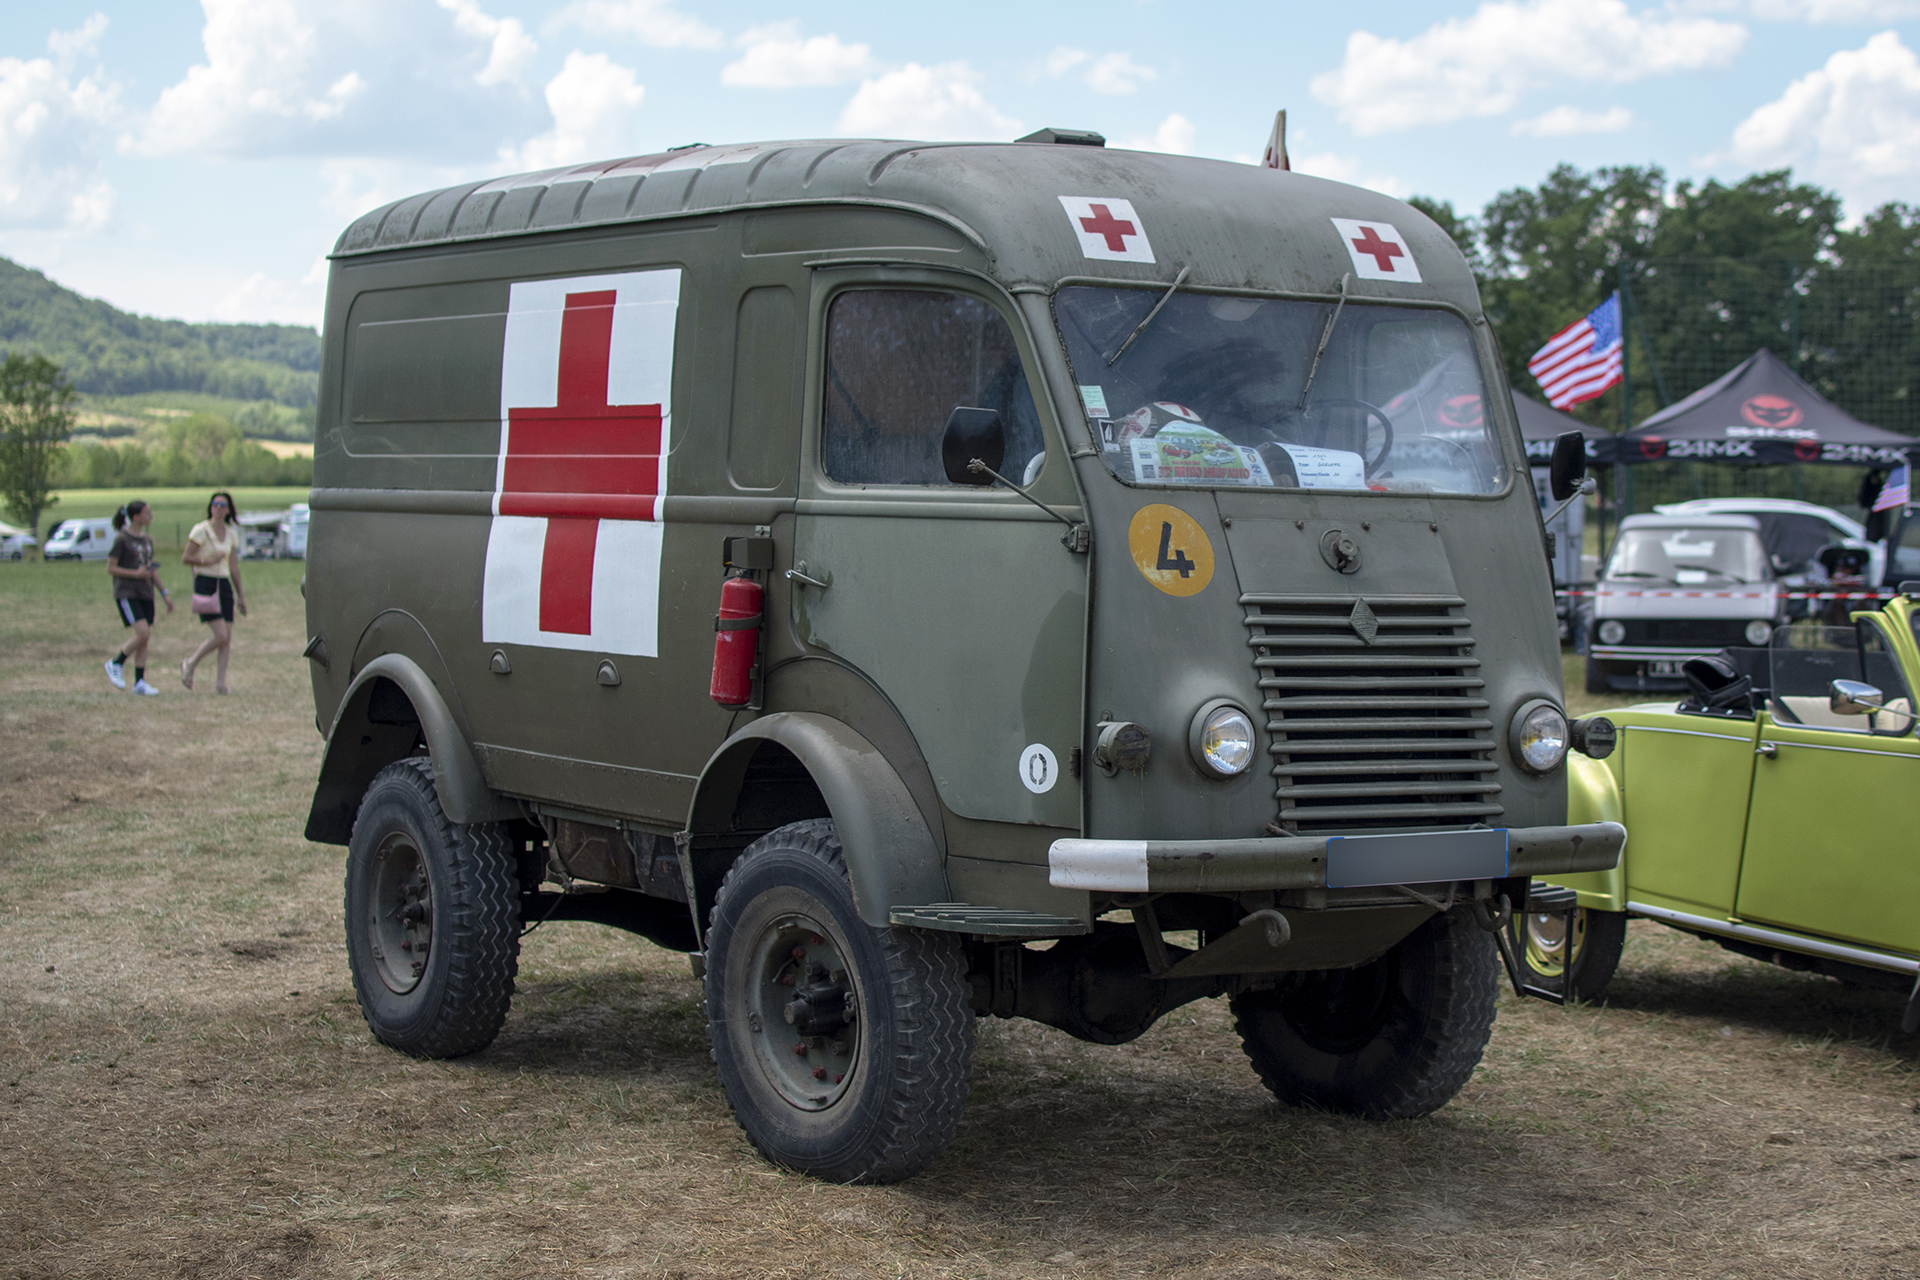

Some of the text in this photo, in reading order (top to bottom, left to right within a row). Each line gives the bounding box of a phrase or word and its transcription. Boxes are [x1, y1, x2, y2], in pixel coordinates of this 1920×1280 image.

[1667, 439, 1757, 457] 24MX
[1821, 443, 1909, 463] 24MX
[1156, 521, 1195, 578] 4
